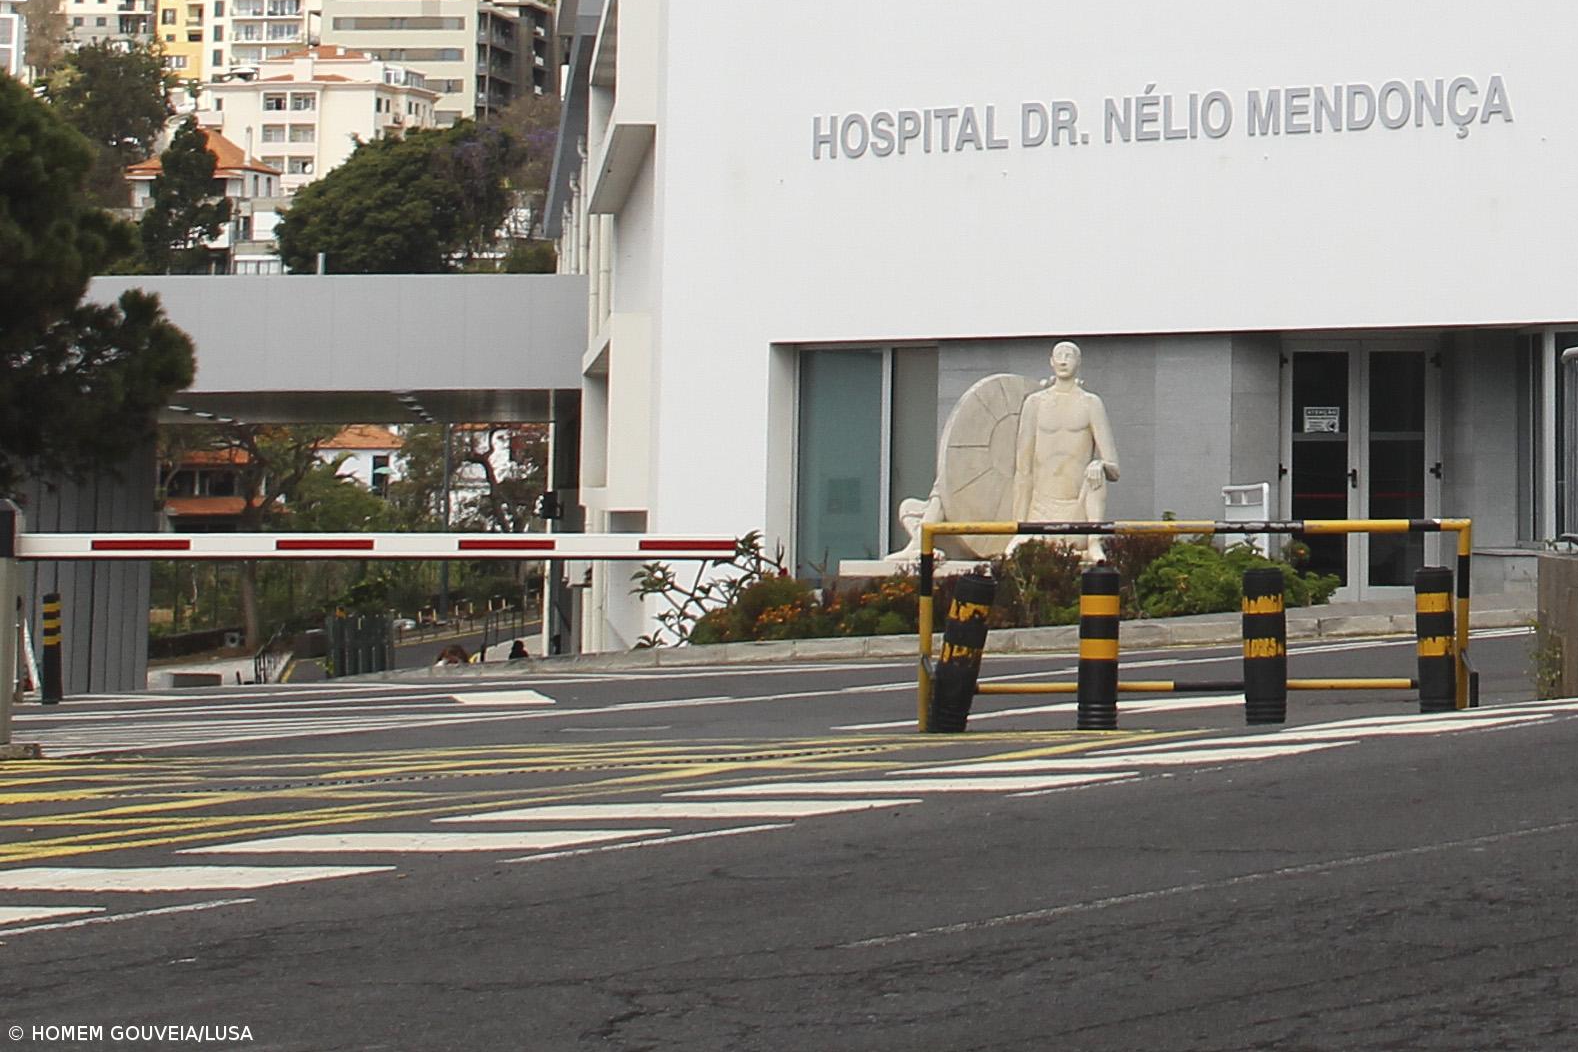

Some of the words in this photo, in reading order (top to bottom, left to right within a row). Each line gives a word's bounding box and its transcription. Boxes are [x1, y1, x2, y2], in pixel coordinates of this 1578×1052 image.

[812, 104, 1009, 159] HOSPITAL
[1020, 100, 1090, 148] DR.
[1104, 84, 1233, 142] NÉLIO
[1247, 75, 1513, 139] MENDONÇA
